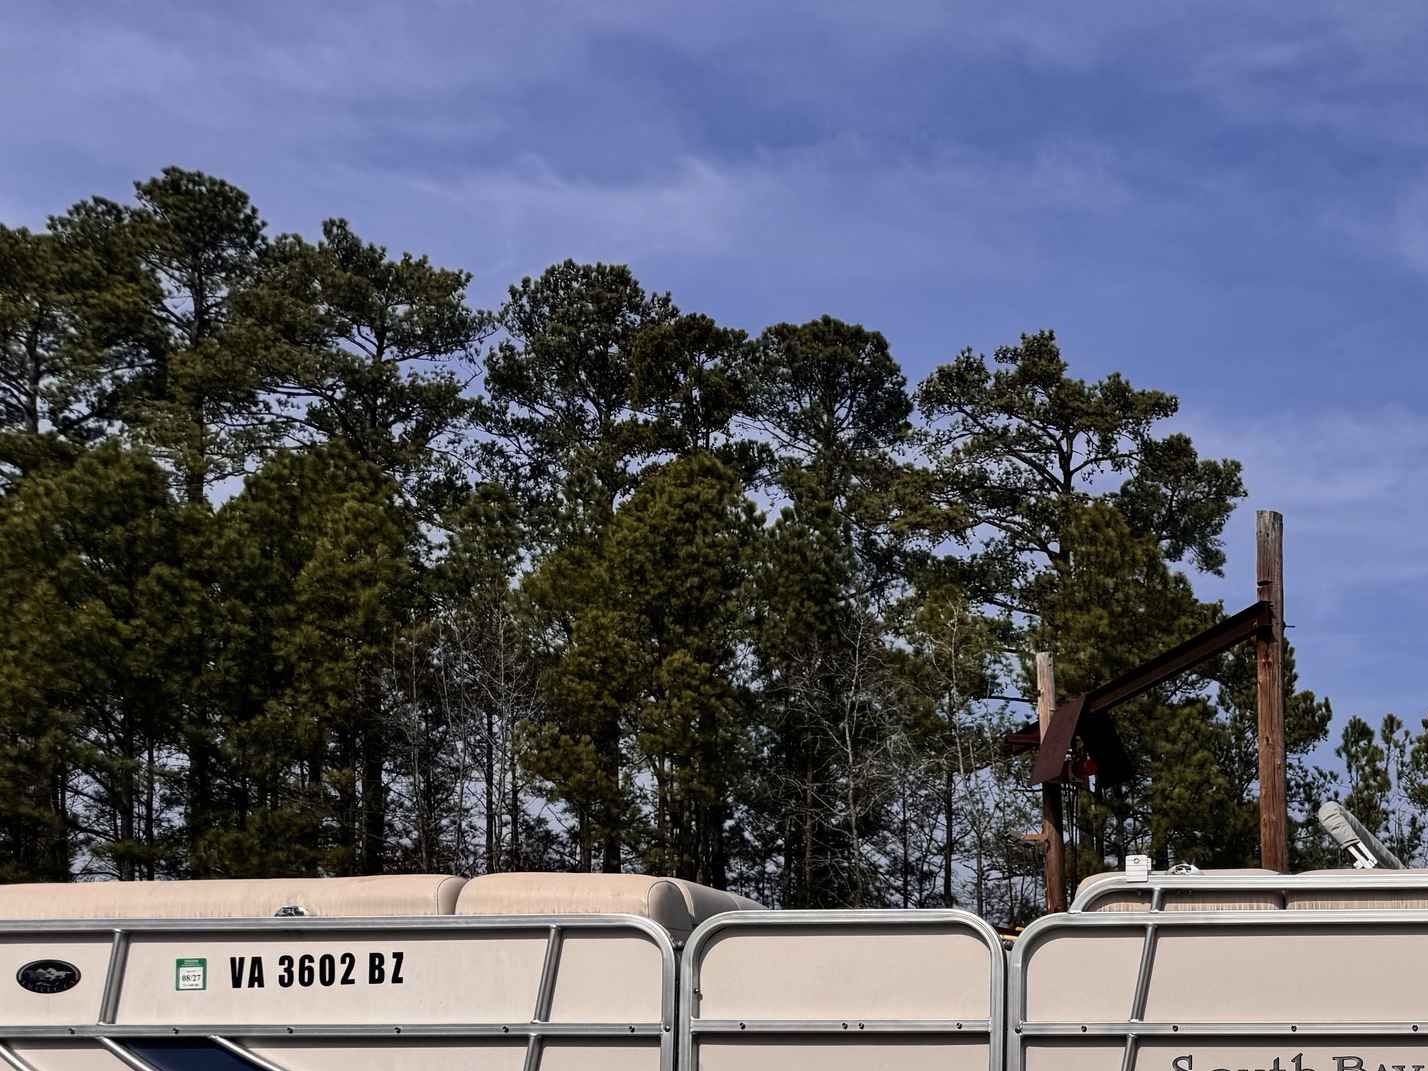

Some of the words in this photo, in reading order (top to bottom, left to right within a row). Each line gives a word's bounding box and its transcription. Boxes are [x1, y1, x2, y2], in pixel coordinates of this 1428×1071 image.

[230, 956, 265, 988] VA
[278, 952, 356, 988] 3602
[368, 951, 404, 985] BZ
